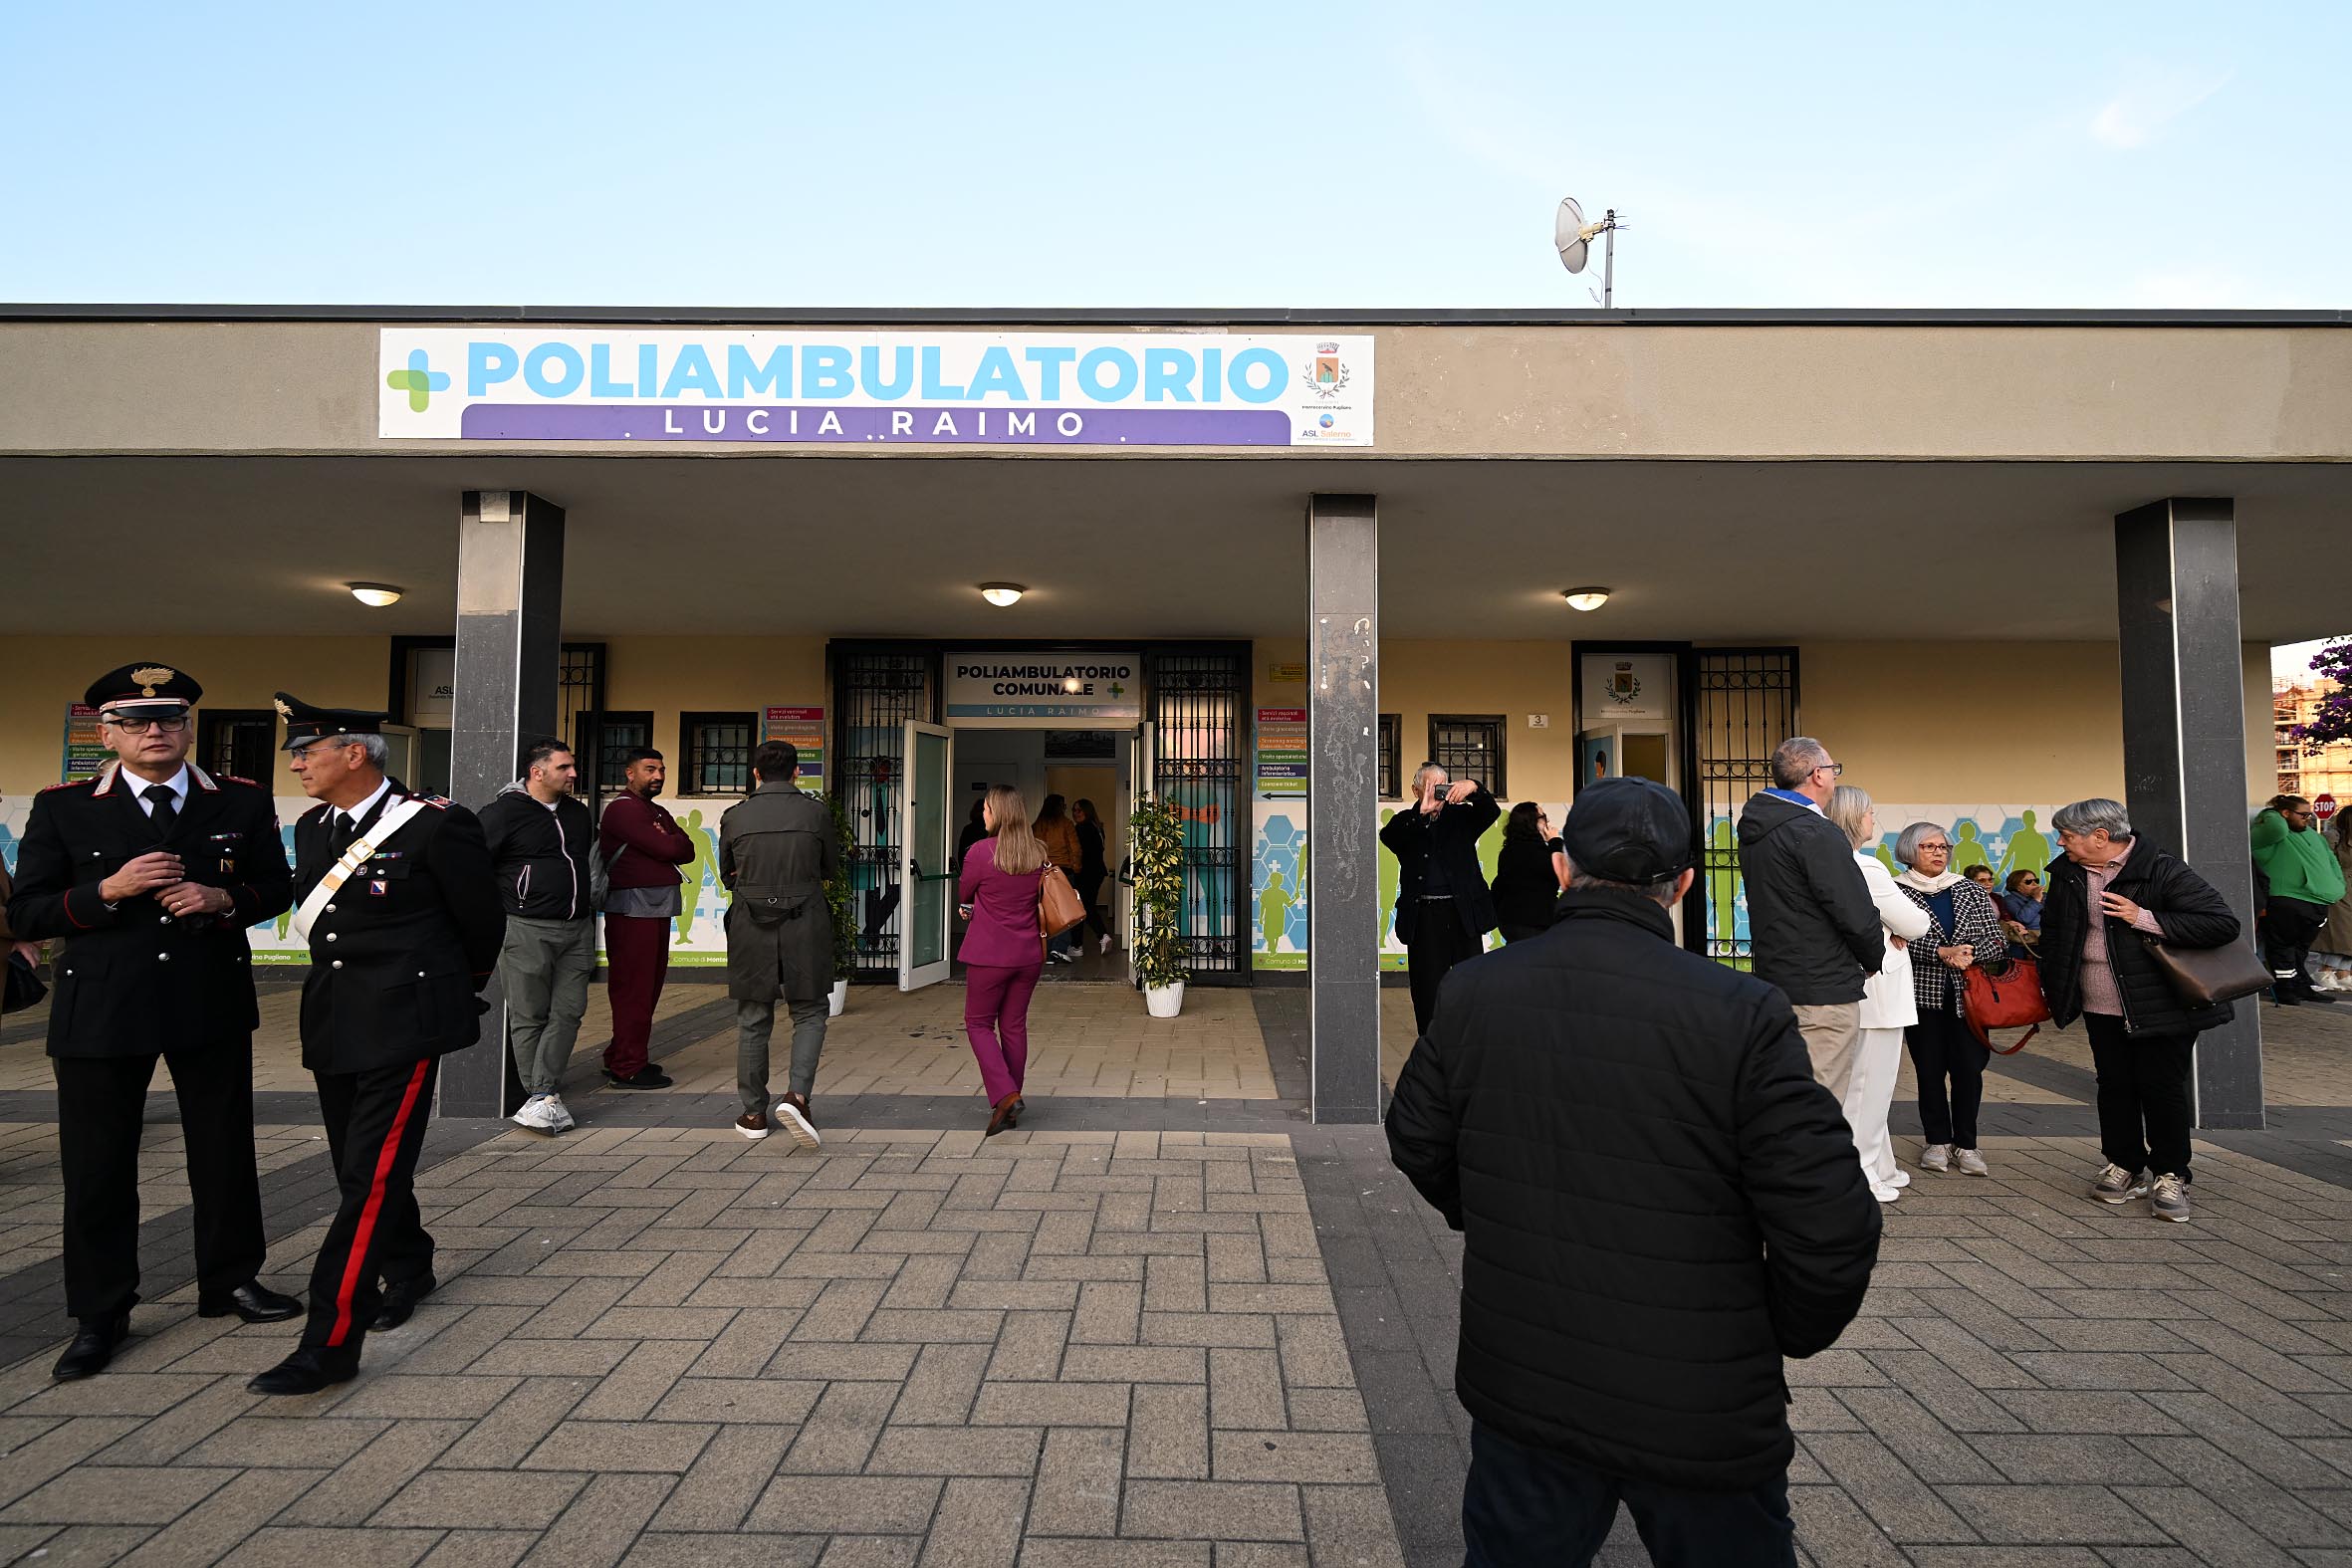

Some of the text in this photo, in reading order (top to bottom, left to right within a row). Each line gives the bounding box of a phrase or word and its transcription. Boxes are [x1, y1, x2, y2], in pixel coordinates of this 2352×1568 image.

[468, 341, 1289, 403] POLIAMBULATORIO
[664, 409, 1083, 437] LUCIA RAIMO
[957, 666, 1131, 679] POLIAMBULATORIO
[2314, 801, 2335, 811] STOP
